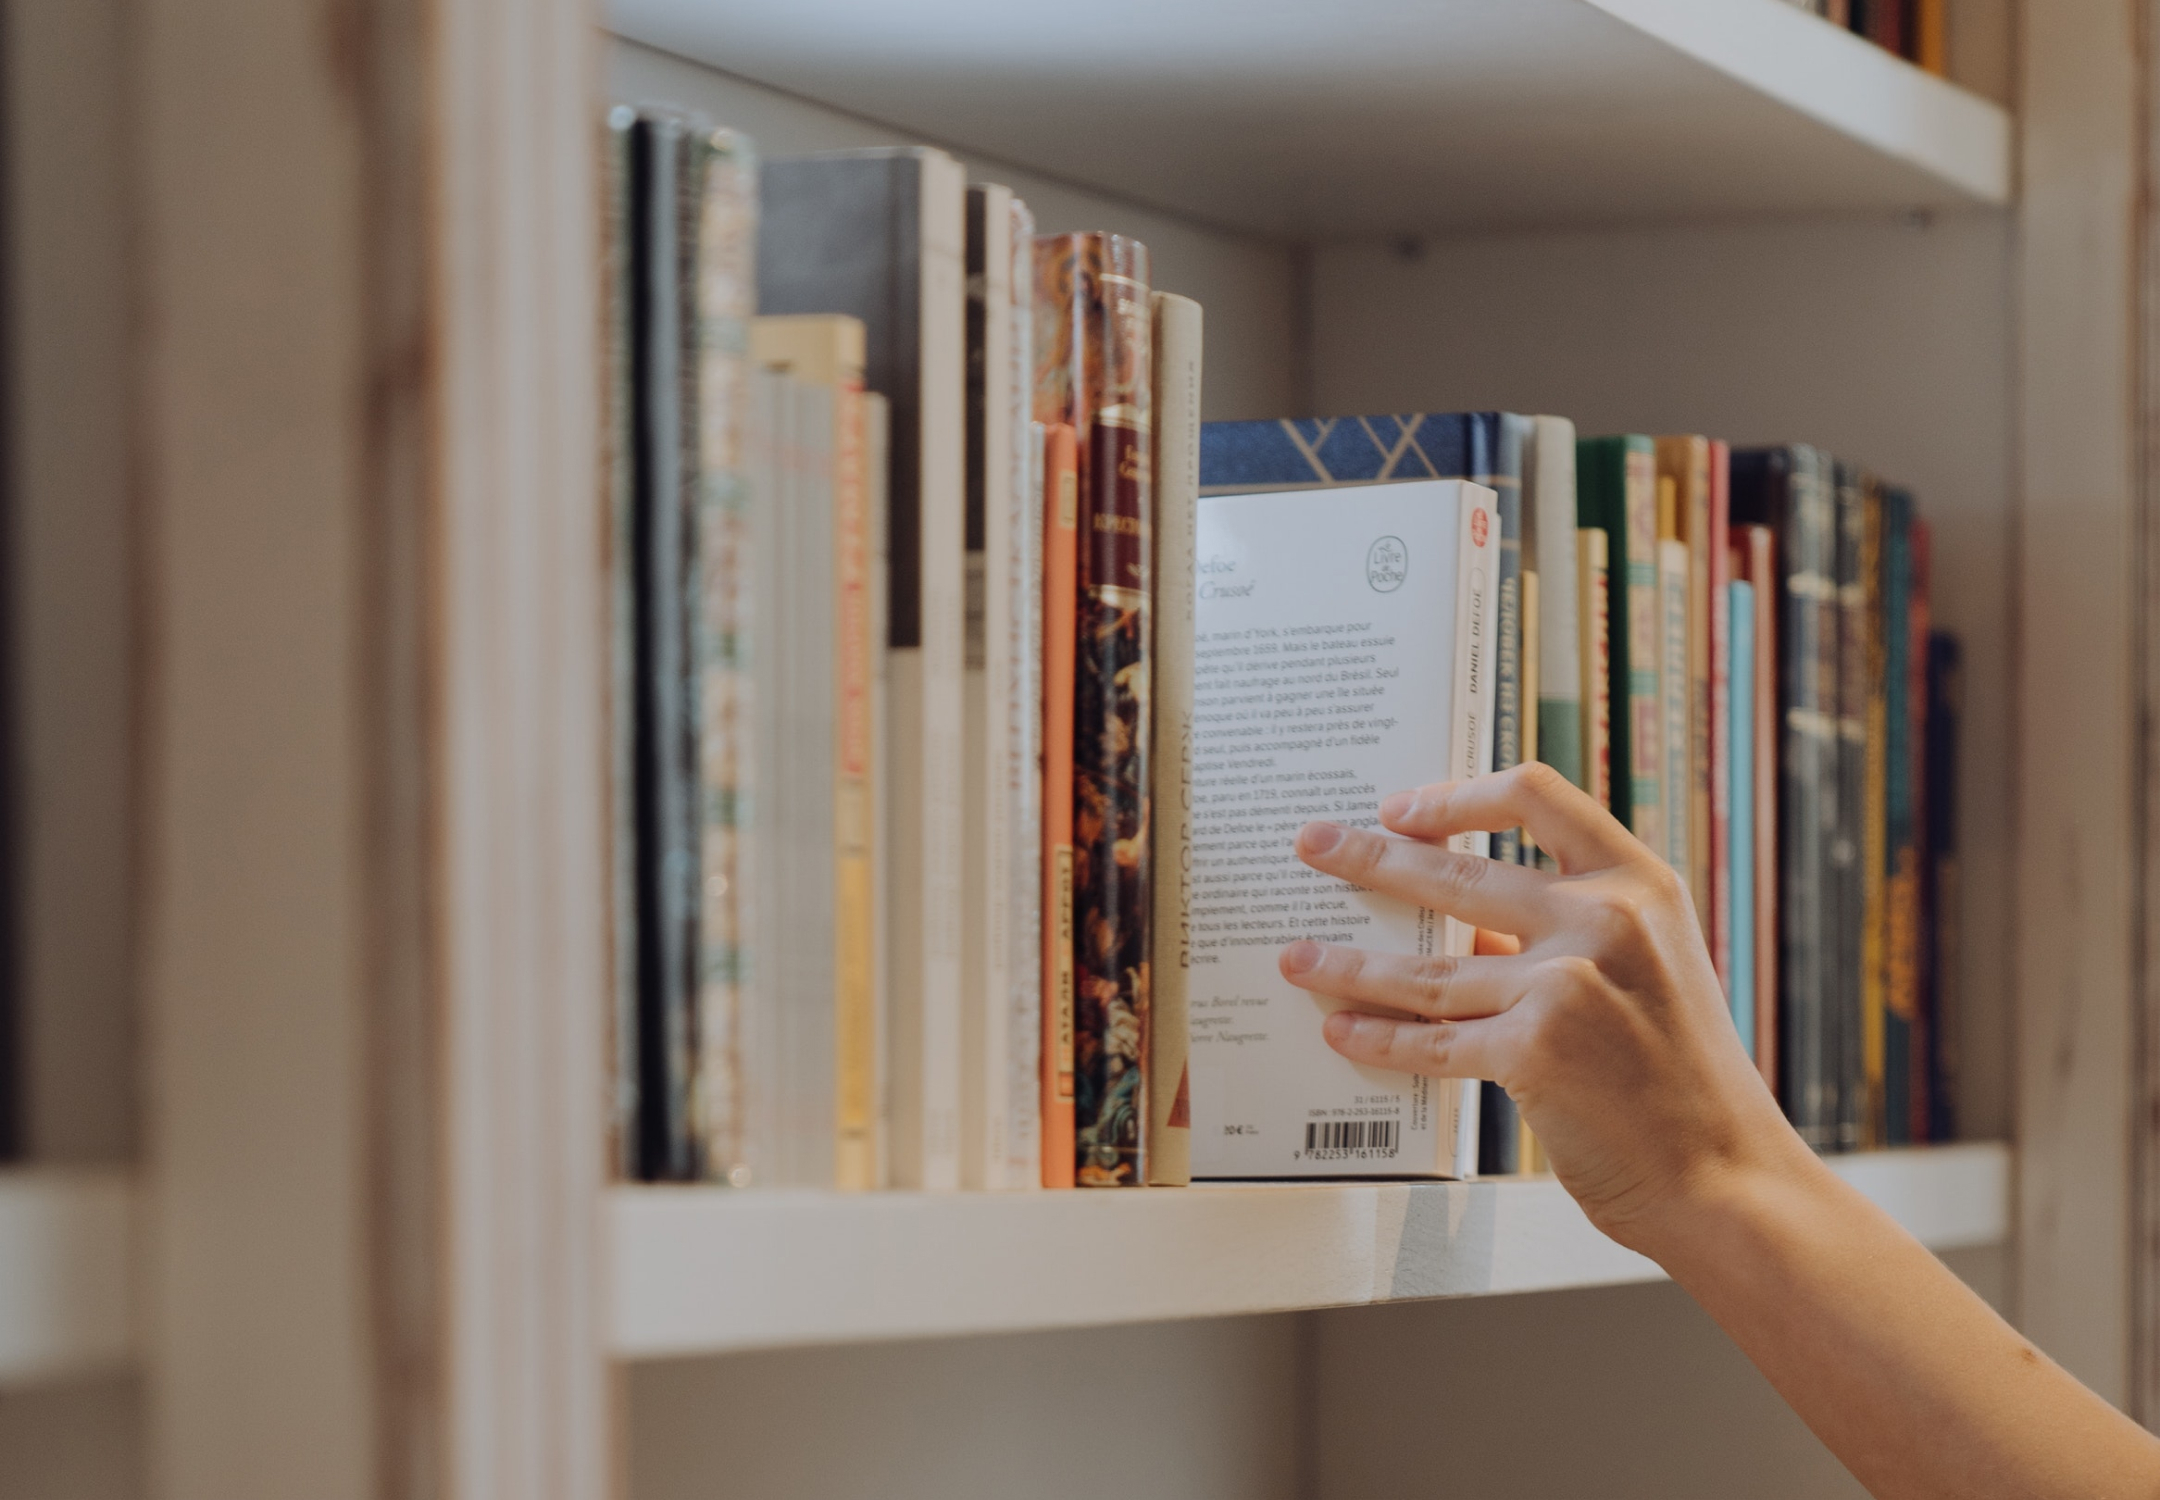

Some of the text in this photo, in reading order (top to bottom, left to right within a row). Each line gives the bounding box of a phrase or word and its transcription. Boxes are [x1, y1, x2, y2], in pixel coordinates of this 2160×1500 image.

[1196, 554, 1236, 574] efoe
[1373, 551, 1401, 564] Livre
[1371, 570, 1405, 583] Poche
[1347, 622, 1372, 635] pour
[1282, 641, 1308, 652] Mais
[1310, 640, 1320, 651] le
[1321, 639, 1359, 651] bateau
[1360, 636, 1395, 648] essuie
[1469, 588, 1482, 694] DANIEL DEFOE
[1280, 657, 1325, 672] pendant
[1327, 654, 1377, 669] plusieurs
[1282, 676, 1296, 686] au
[1297, 672, 1323, 684] nord
[1324, 671, 1338, 682] du
[1376, 665, 1400, 679] Seul
[1273, 691, 1313, 705] gagner
[1315, 690, 1335, 700] une
[1352, 684, 1385, 697] située
[1259, 709, 1272, 719] va
[1273, 708, 1294, 721] peu
[1304, 706, 1325, 719] peu
[1327, 703, 1374, 716] s'assurer
[1201, 725, 1263, 739] convenable
[1286, 722, 1324, 735] restera
[1326, 720, 1350, 734] près
[1351, 719, 1366, 729] de
[1229, 743, 1251, 756] puis
[1253, 738, 1322, 753] accompagné
[1349, 733, 1380, 746] fidèle
[1275, 771, 1306, 782] marin
[1307, 768, 1358, 782] écossais,
[1211, 792, 1237, 804] paru
[1238, 791, 1251, 801] en
[1323, 786, 1337, 797] un
[1338, 782, 1376, 796] succès
[1228, 808, 1247, 821] pas
[1293, 801, 1331, 816] depuis.
[1333, 799, 1343, 812] Si
[1346, 799, 1378, 812] James
[1208, 825, 1222, 836] de
[1223, 822, 1254, 835] Defoe
[1256, 821, 1266, 833] le
[1274, 820, 1298, 834] père
[1180, 710, 1192, 969] ВИКТОР СЕРЖ
[1228, 839, 1257, 853] parce
[1259, 839, 1279, 852] que
[1211, 858, 1224, 868] un
[1226, 854, 1290, 868] authentique
[1203, 872, 1230, 884] aussi
[1232, 871, 1263, 884] parce
[1289, 868, 1313, 880] crée
[1201, 887, 1248, 900] ordinaire
[1250, 886, 1269, 899] qui
[1270, 884, 1311, 897] raconte
[1313, 884, 1333, 895] son
[1250, 902, 1290, 914] comme
[1314, 898, 1349, 911] vécue,
[1198, 913, 1371, 932] tous les lecteurs. Et cette histoire
[1198, 938, 1218, 950] que
[1294, 1148, 1396, 1160] 9 782253 161158
